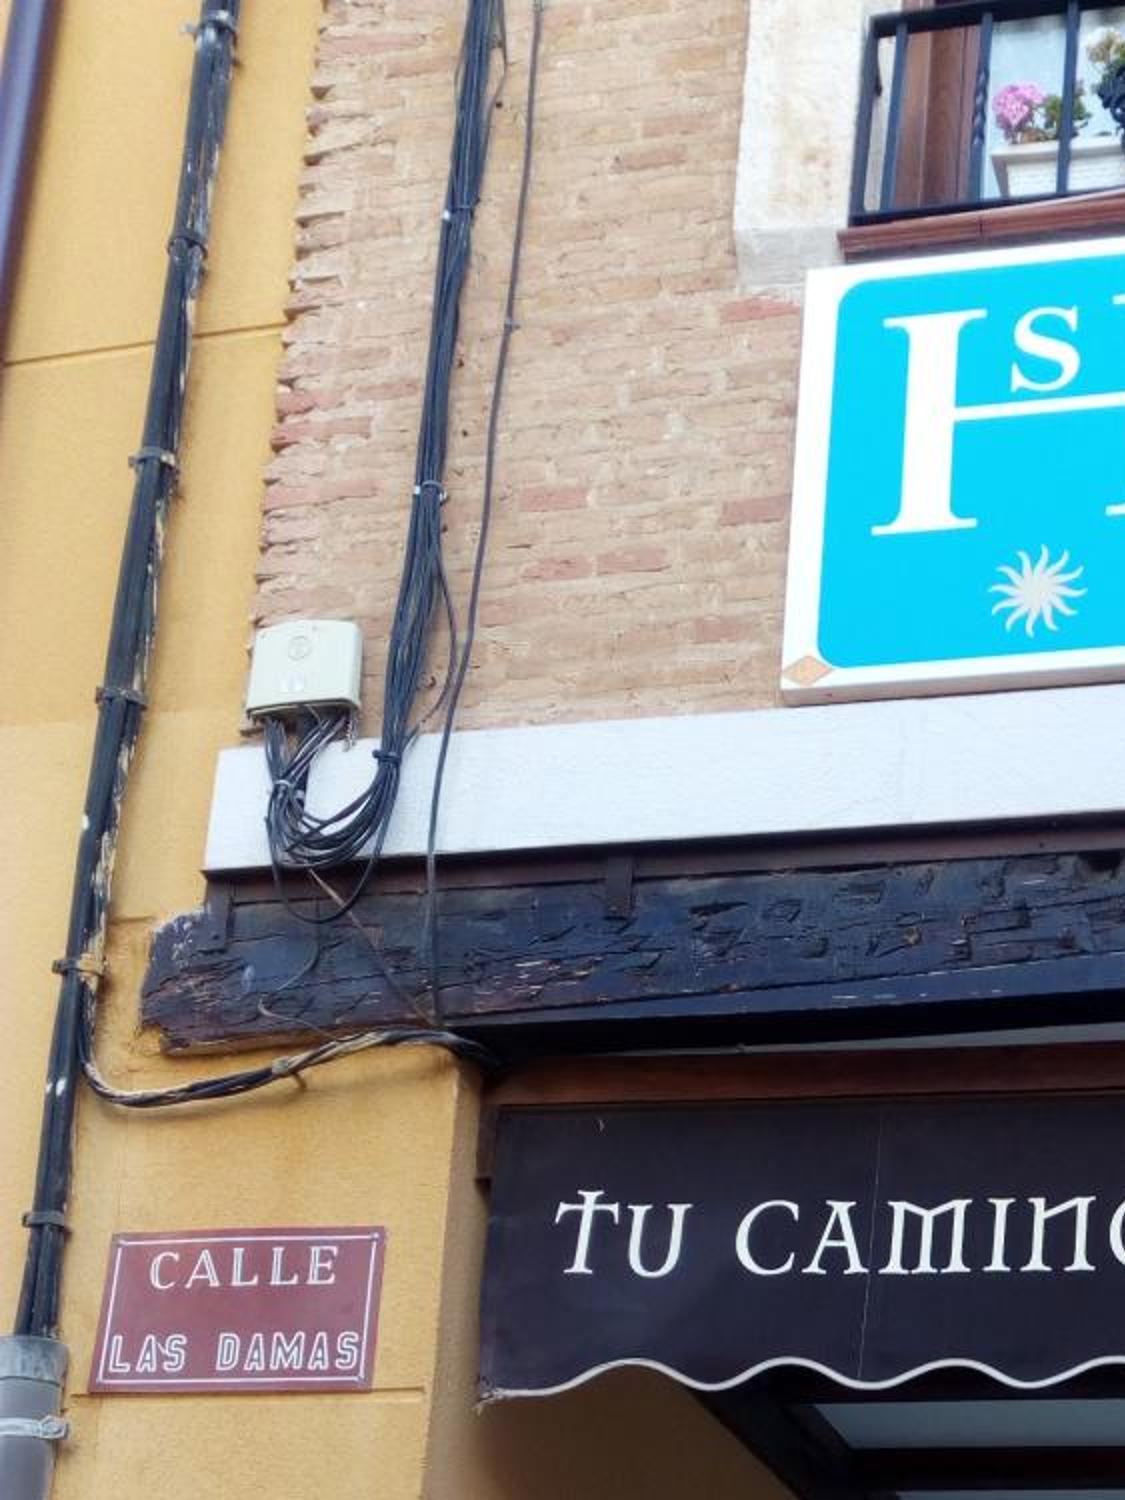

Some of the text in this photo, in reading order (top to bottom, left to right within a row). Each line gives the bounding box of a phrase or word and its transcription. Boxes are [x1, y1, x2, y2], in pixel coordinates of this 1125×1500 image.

[555, 1189, 694, 1278] TU
[149, 1245, 339, 1290] CALLE
[107, 1331, 360, 1373] LAS DAMAS
